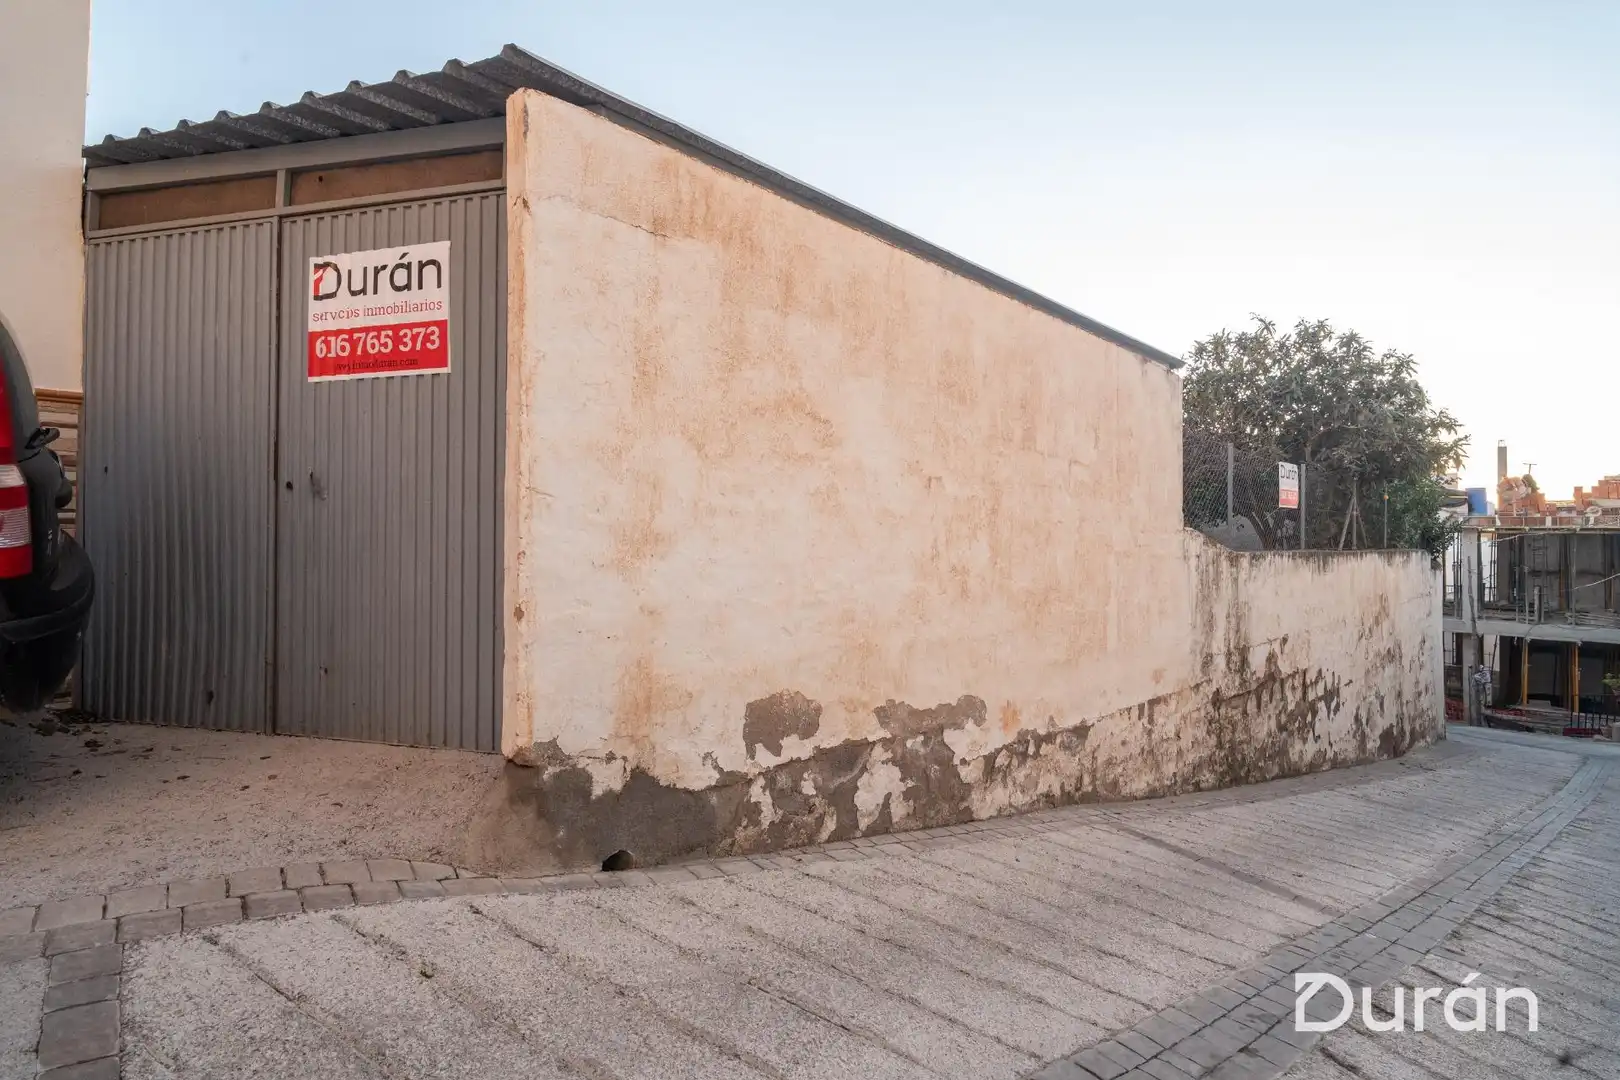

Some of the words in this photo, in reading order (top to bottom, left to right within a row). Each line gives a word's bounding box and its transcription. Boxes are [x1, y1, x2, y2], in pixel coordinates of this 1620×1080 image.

[313, 252, 442, 301] Durán
[363, 299, 443, 317] inmobiliarios
[315, 333, 350, 358] 616
[353, 330, 393, 356] 765
[399, 326, 440, 352] 373
